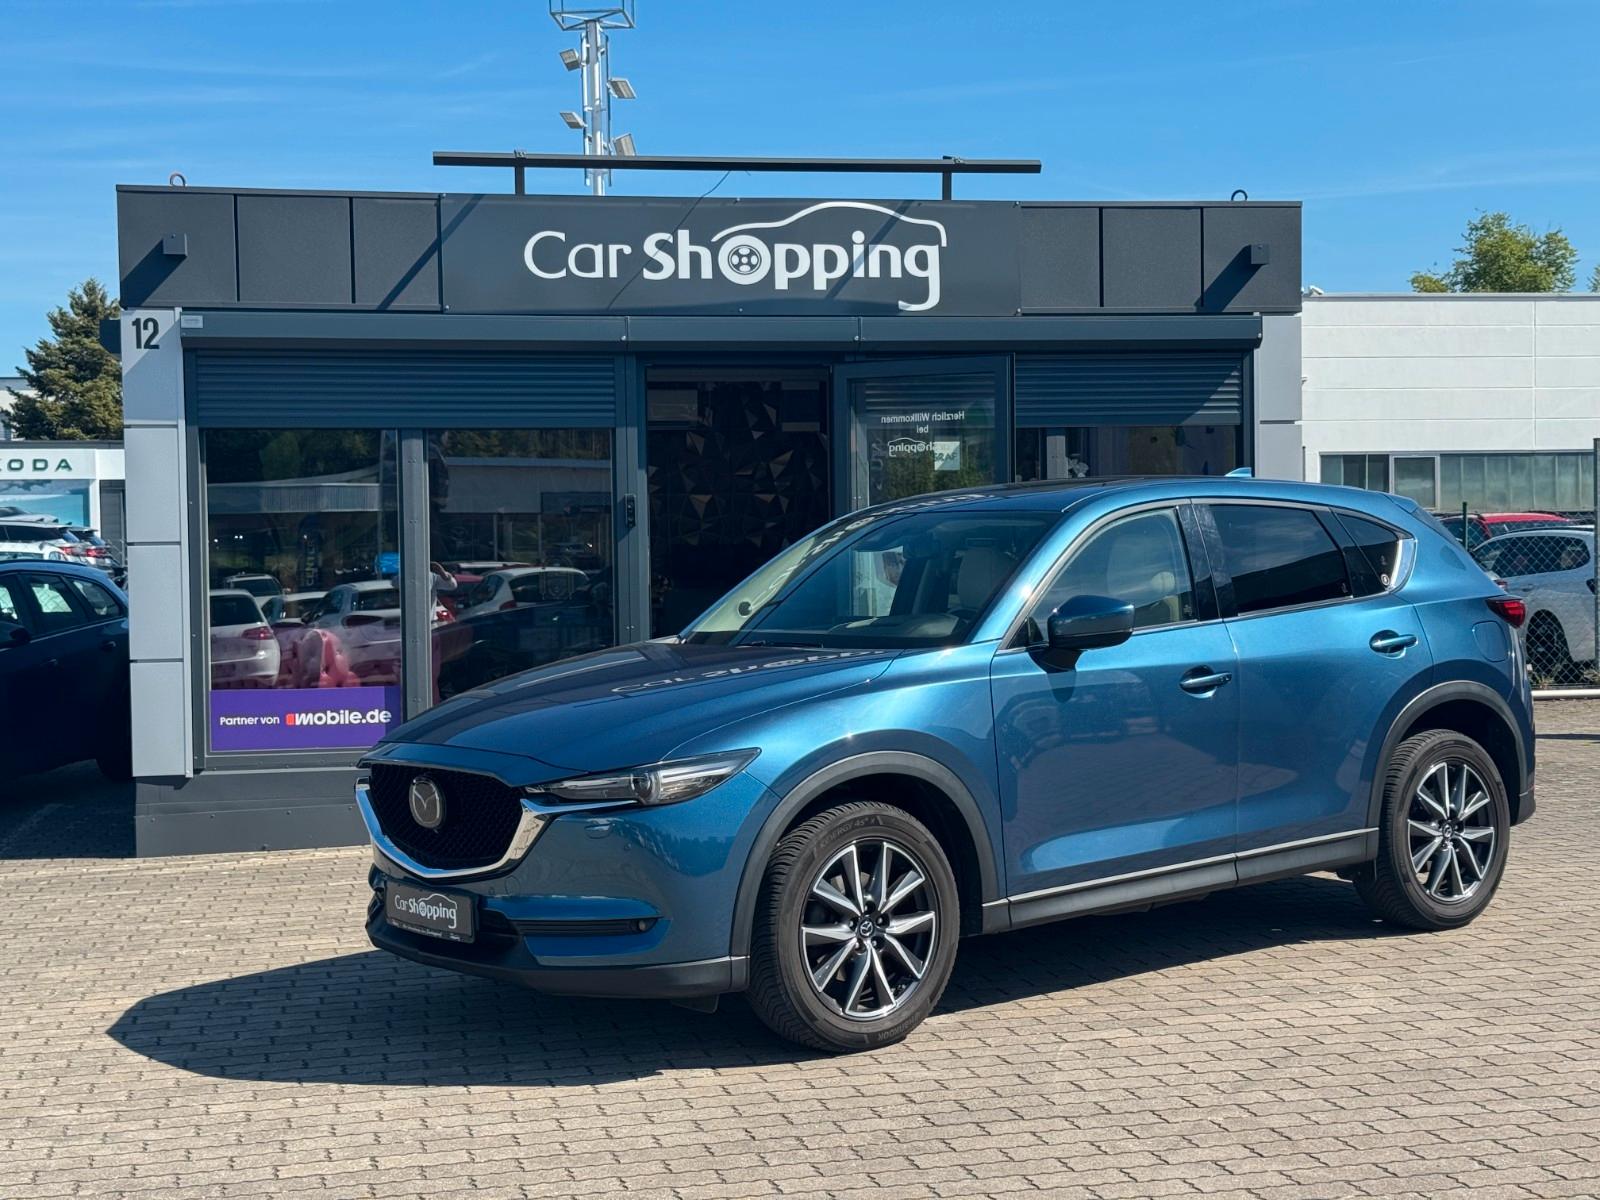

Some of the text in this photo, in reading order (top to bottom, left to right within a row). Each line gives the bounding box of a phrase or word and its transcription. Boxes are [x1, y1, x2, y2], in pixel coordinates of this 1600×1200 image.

[523, 228, 942, 312] Car Shopping
[131, 317, 160, 350] 12
[0, 457, 73, 473] ODA
[219, 708, 392, 727] Partner von mobile.de
[394, 894, 458, 930] Car Shopping
